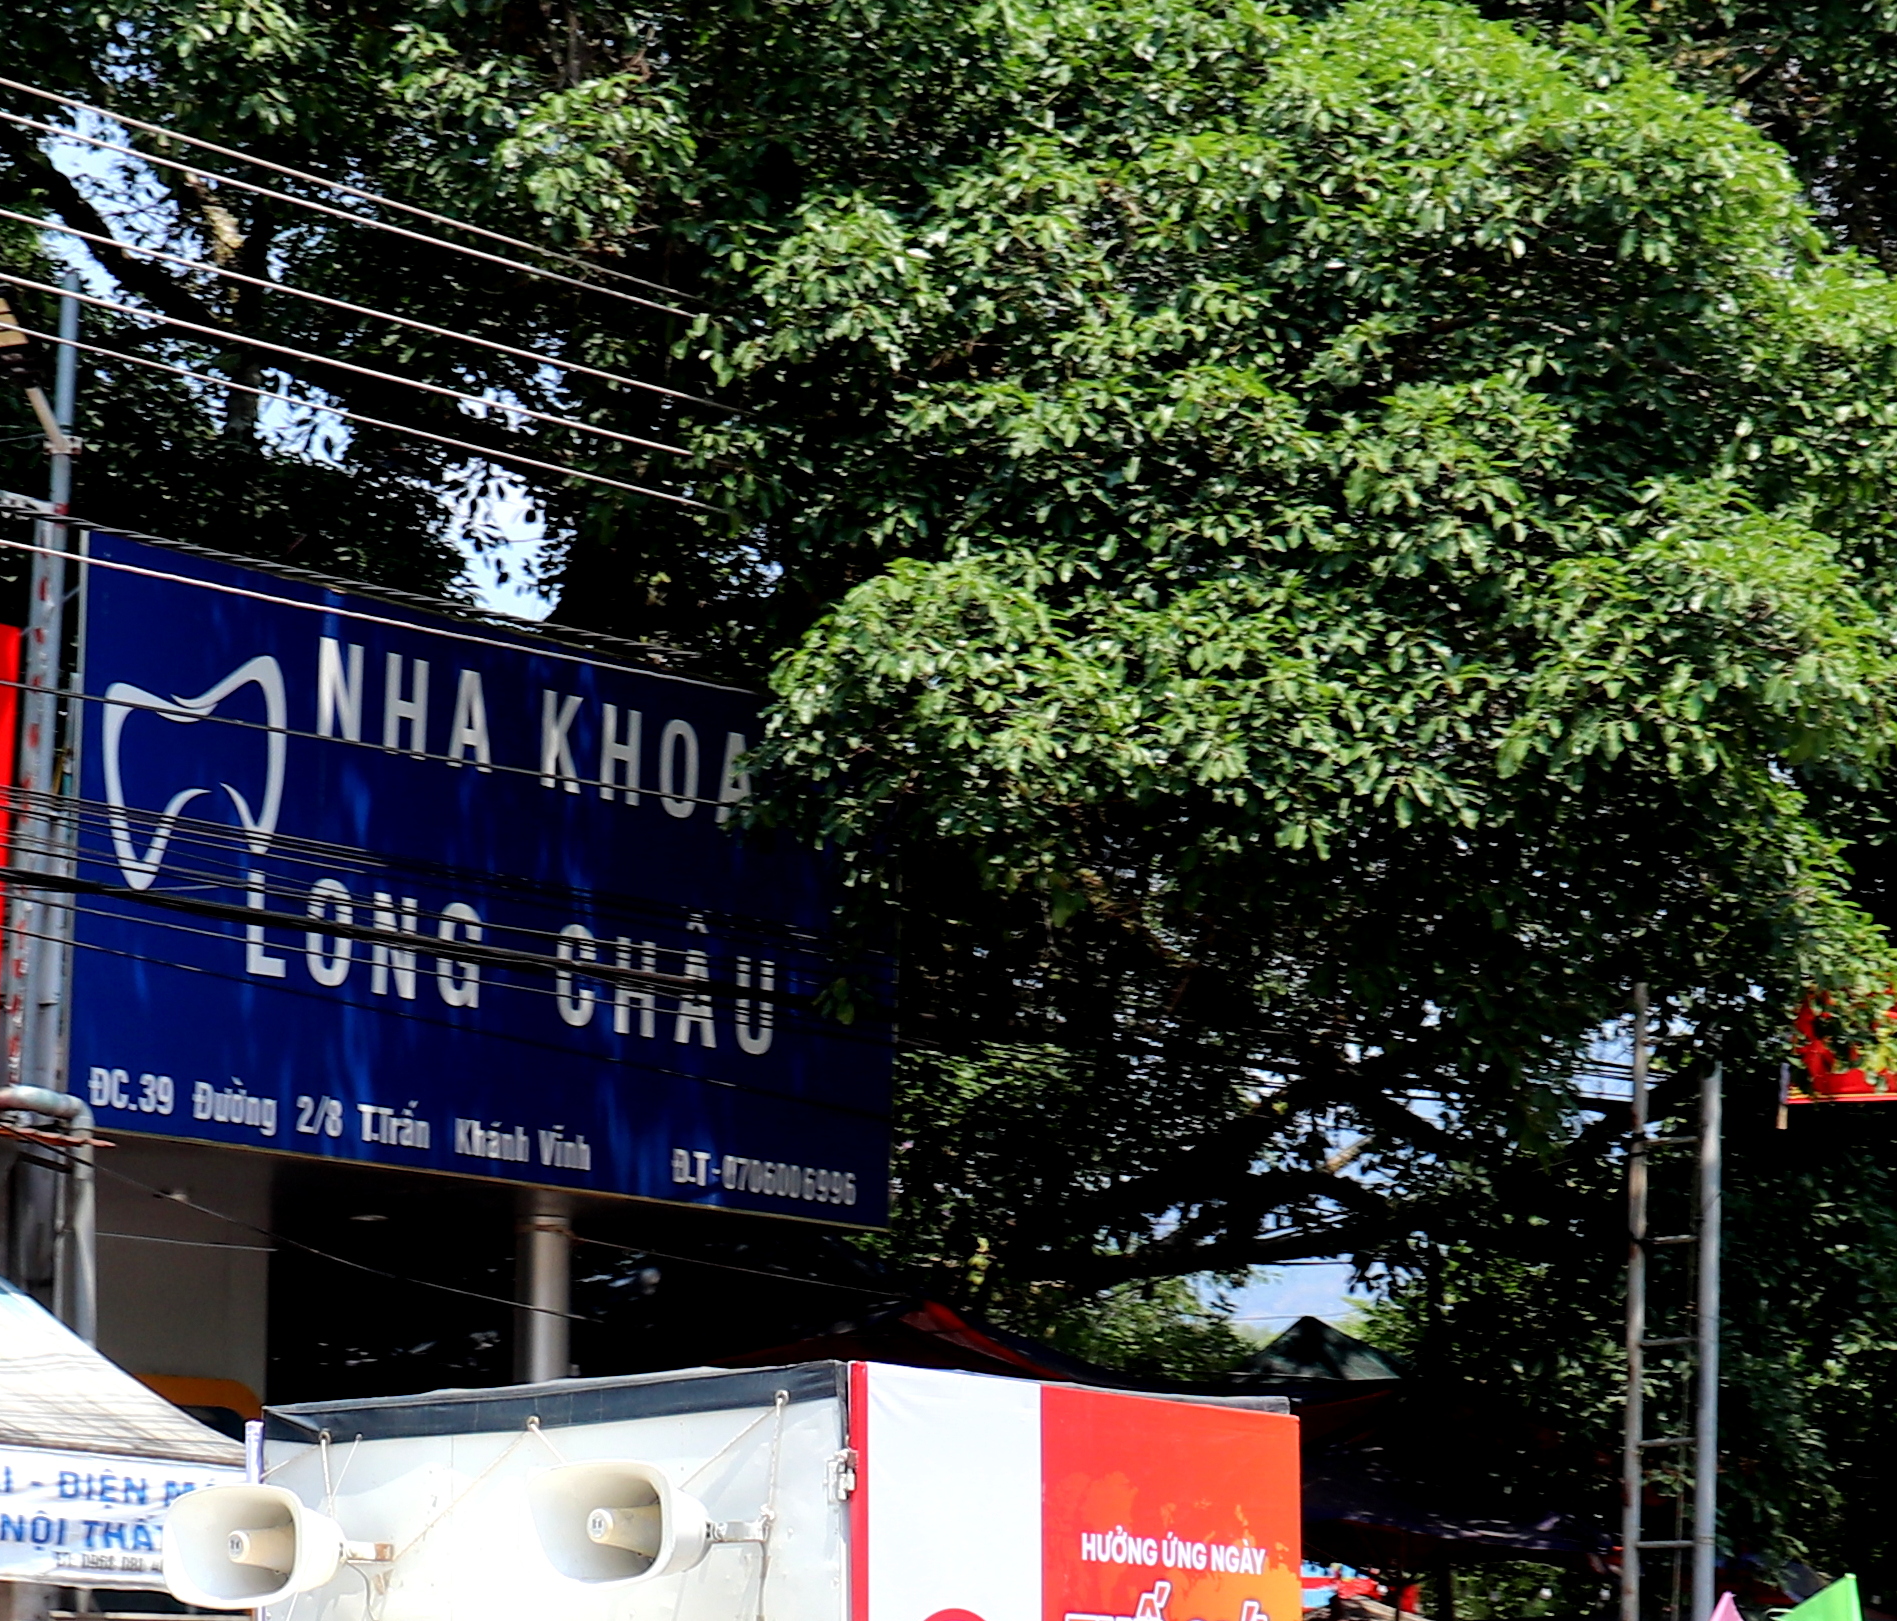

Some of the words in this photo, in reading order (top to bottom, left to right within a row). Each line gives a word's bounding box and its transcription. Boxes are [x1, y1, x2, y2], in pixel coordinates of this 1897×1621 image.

[316, 636, 493, 773] NHA
[540, 689, 754, 824] KHOA
[245, 869, 483, 1009] LONG
[556, 907, 776, 1055] CHÂU
[88, 1065, 176, 1116] ĐC.39
[192, 1075, 278, 1137] Đường
[295, 1094, 344, 1138] 2/8
[454, 1117, 530, 1164] Khánh
[537, 1124, 592, 1171] Vĩnh
[57, 1468, 149, 1510] ĐIỆN
[0, 1509, 67, 1552] NỘI
[1080, 1524, 1158, 1567] HƯỞNG
[1161, 1531, 1208, 1571] ỨNG
[1210, 1538, 1267, 1576] NGÀY
